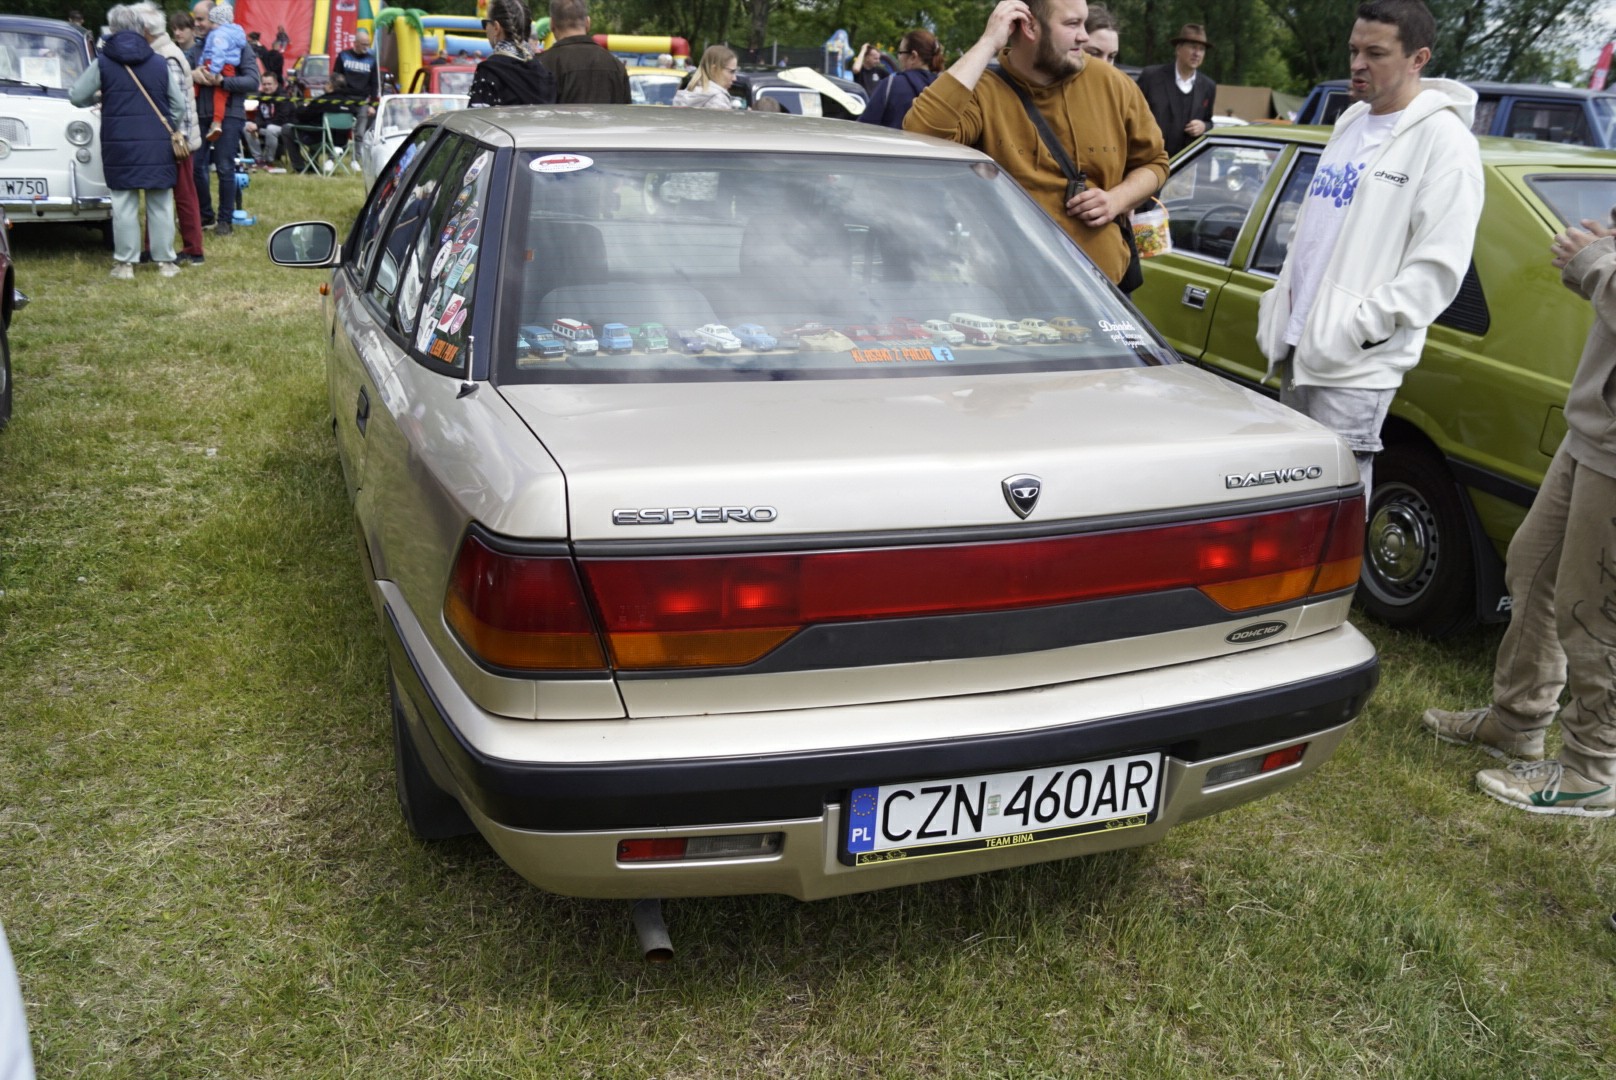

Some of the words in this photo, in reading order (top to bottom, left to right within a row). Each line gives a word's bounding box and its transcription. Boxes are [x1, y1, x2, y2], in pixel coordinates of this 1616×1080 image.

[1226, 466, 1322, 489] DAEWOO
[612, 505, 778, 525] ESPERO
[882, 780, 987, 842] CZN
[1003, 760, 1154, 826] 460AR
[851, 827, 871, 843] PL
[985, 836, 1011, 848] TEAM
[1012, 833, 1034, 844] BINA
